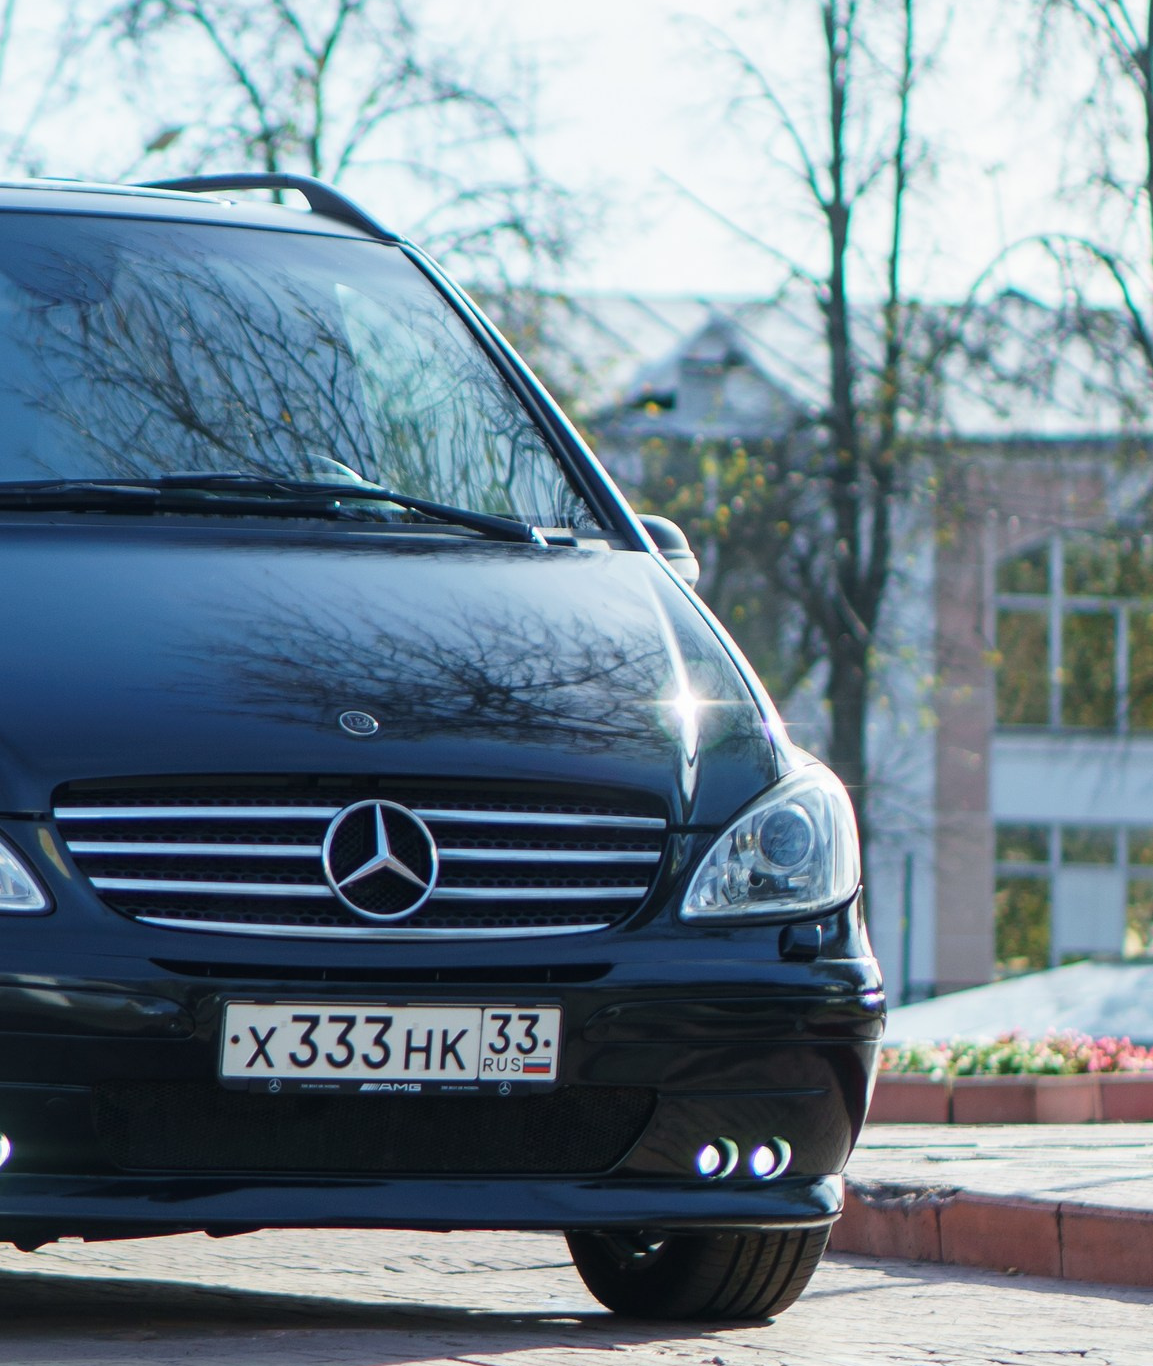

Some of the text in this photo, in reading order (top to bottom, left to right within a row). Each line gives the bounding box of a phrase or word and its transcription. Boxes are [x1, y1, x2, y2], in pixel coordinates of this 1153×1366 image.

[488, 1014, 540, 1054] 33
[482, 1058, 521, 1072] RUS
[378, 1083, 422, 1092] AMG
